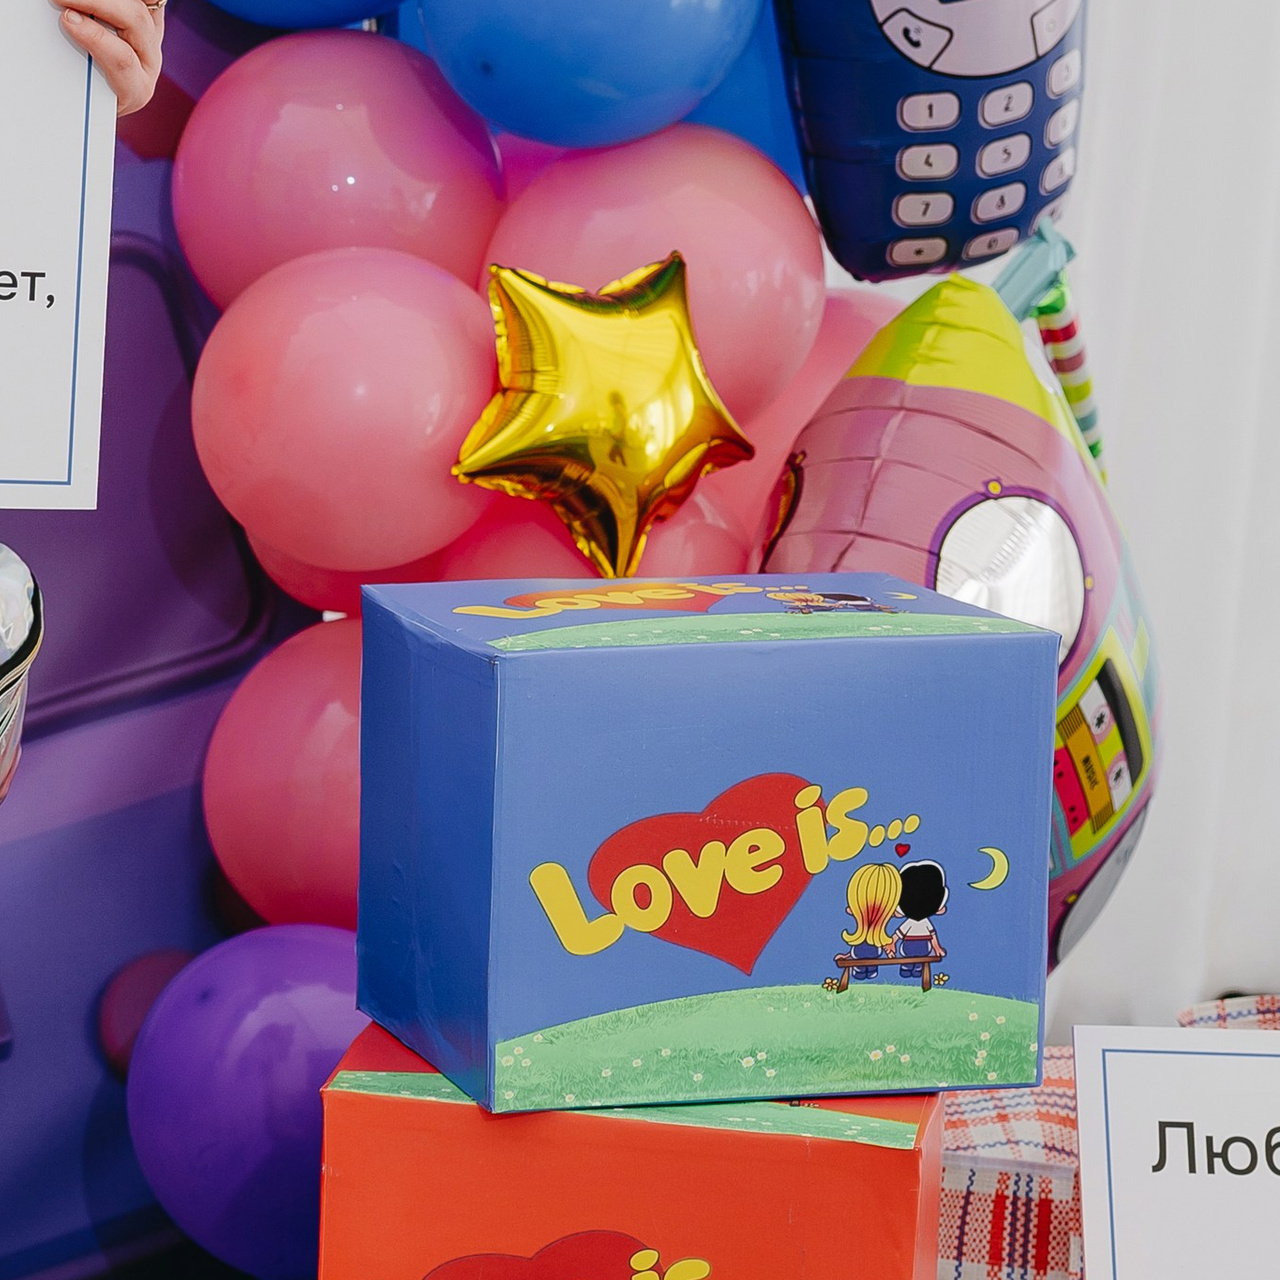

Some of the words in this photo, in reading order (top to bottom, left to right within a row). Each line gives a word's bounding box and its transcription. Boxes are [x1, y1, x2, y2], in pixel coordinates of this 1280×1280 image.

[452, 588, 694, 619] Love
[528, 826, 786, 956] Love
[793, 784, 922, 875] is...
